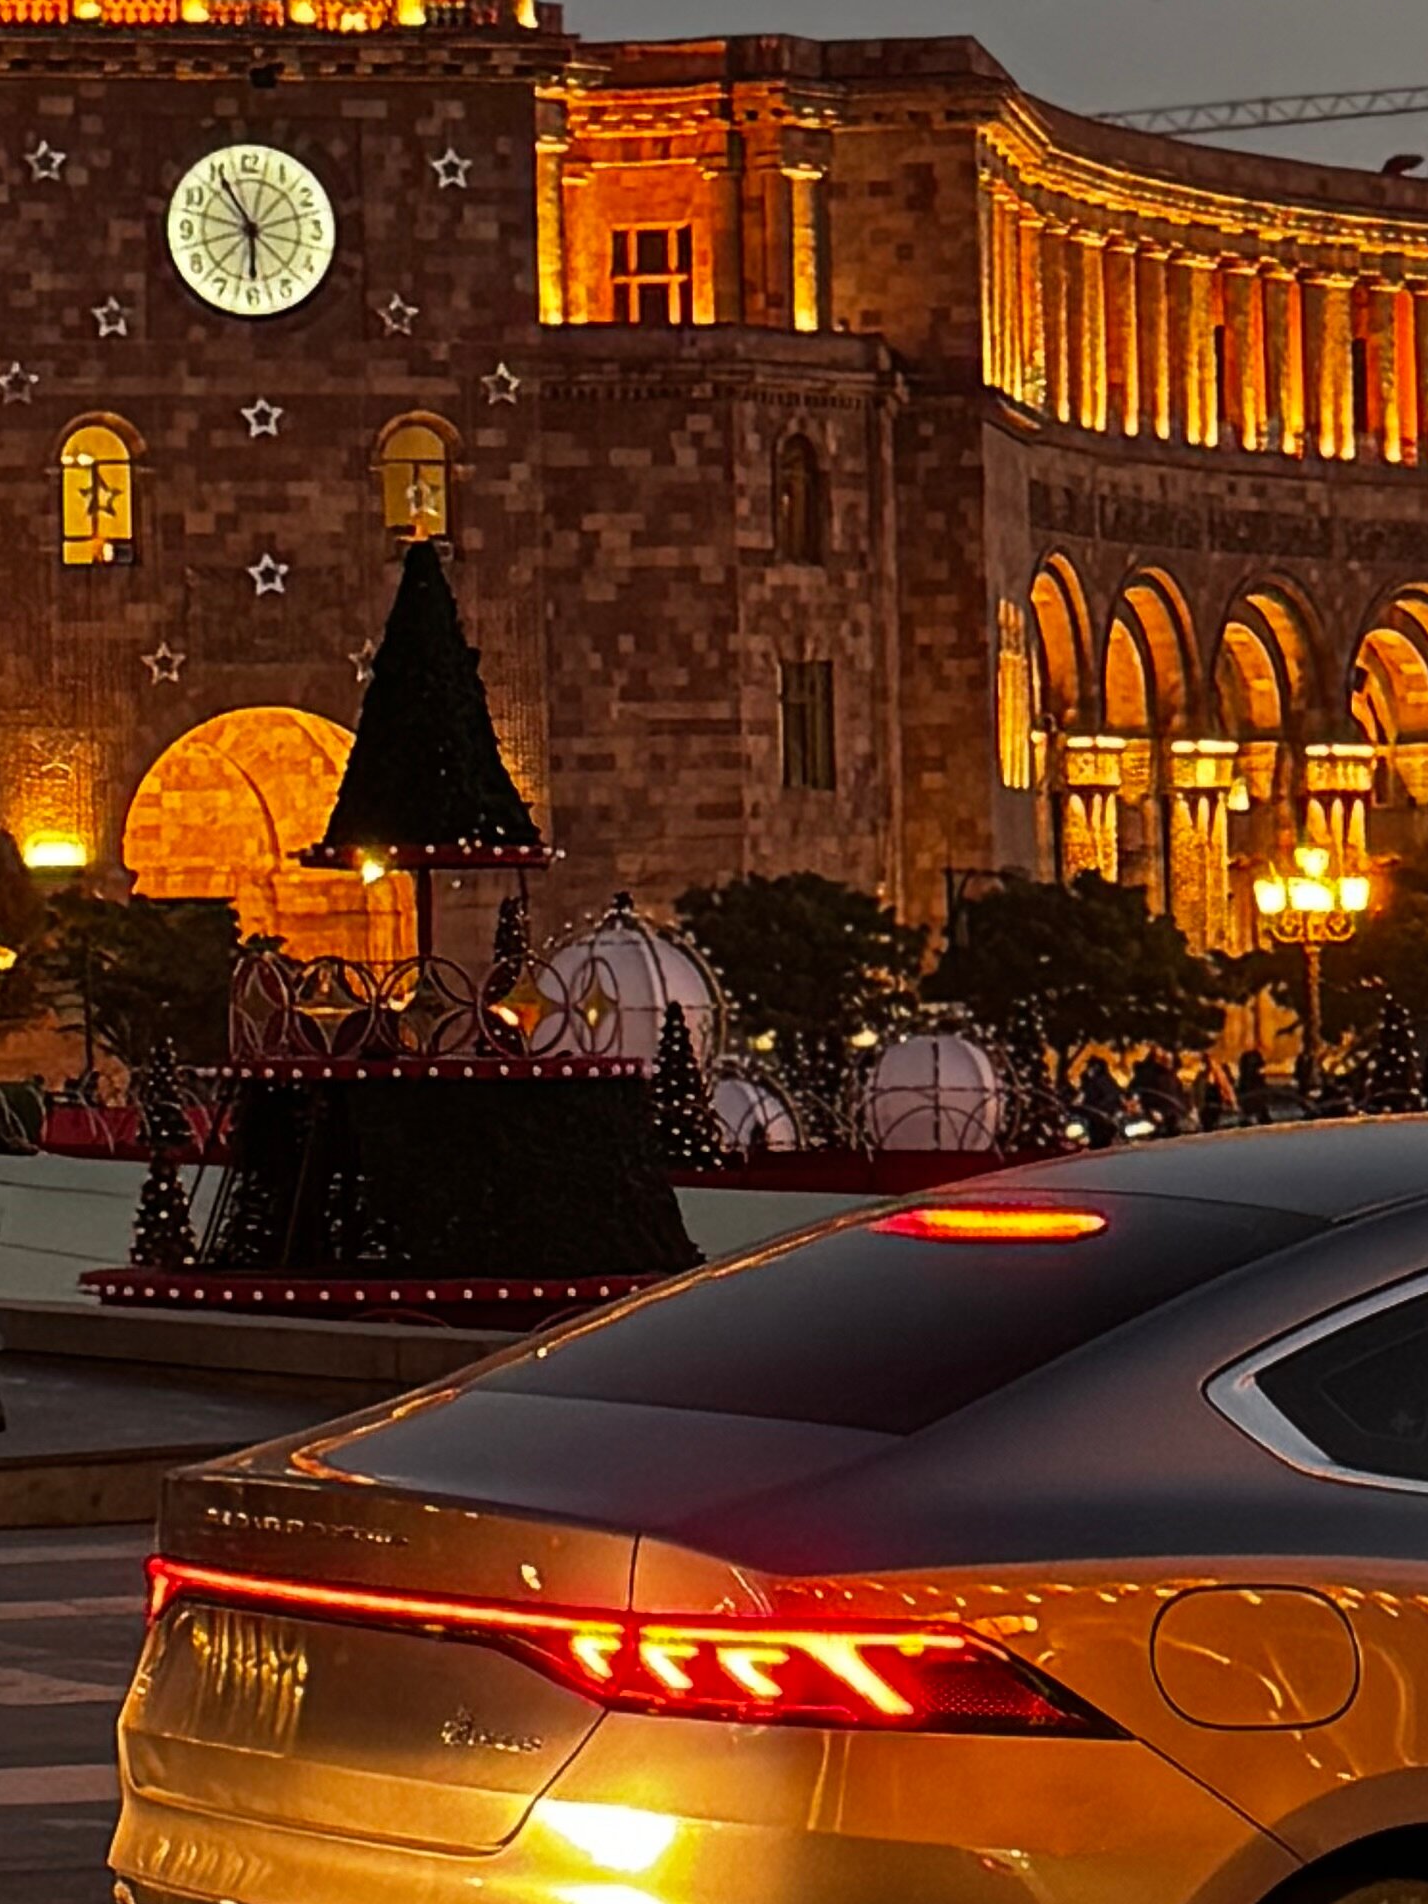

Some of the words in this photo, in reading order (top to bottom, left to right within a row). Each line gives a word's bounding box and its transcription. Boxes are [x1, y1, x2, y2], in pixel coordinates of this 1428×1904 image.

[300, 186, 314, 207] 2
[179, 219, 194, 240] 9
[212, 277, 228, 298] 7
